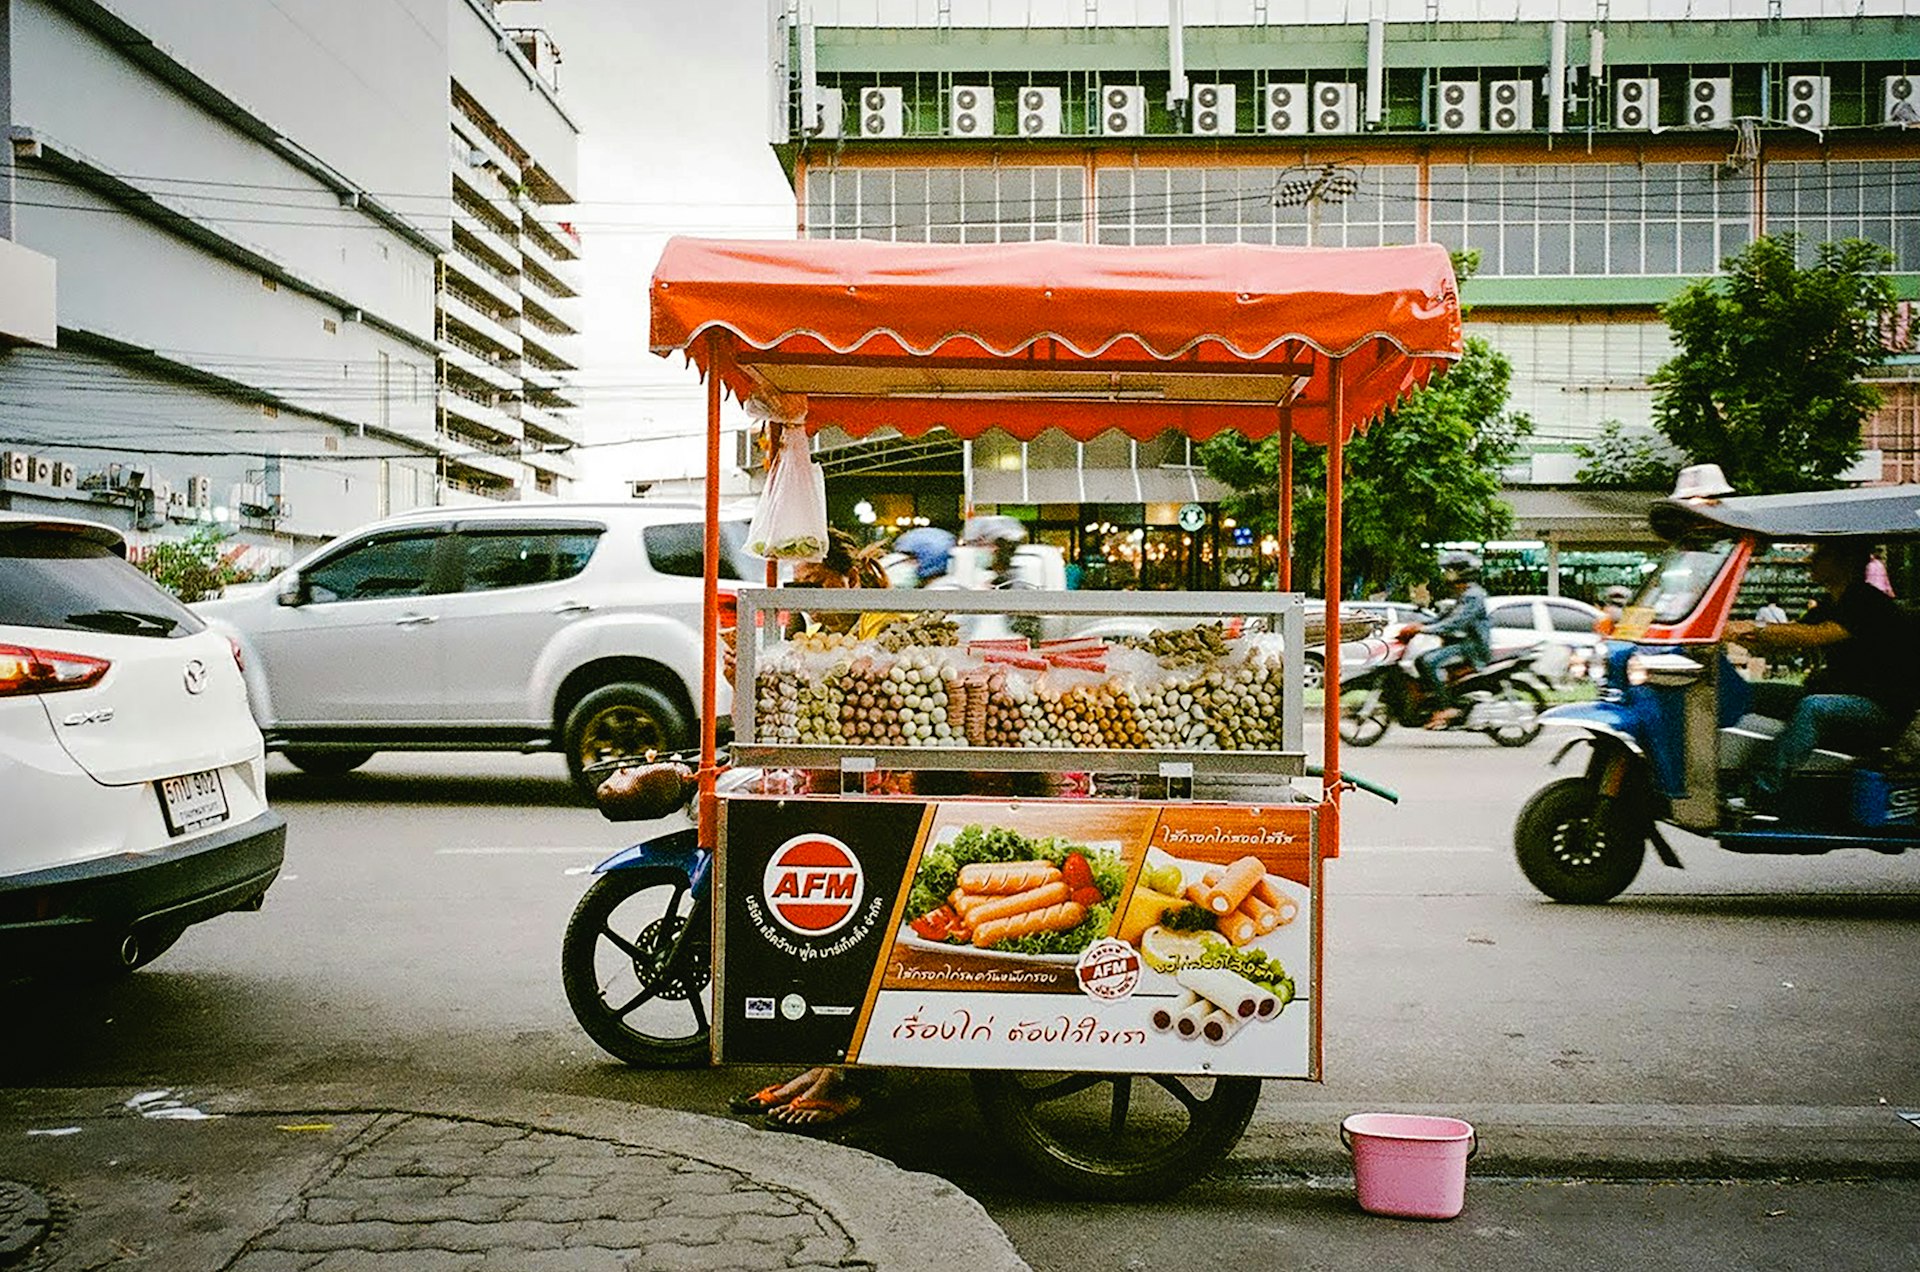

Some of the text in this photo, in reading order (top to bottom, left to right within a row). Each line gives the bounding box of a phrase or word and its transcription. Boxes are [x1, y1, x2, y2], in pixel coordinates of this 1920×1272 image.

[771, 872, 858, 899] AFM
[745, 894, 764, 927] บริษัท
[863, 896, 884, 926] จำกัด
[1092, 959, 1127, 979] AFM
